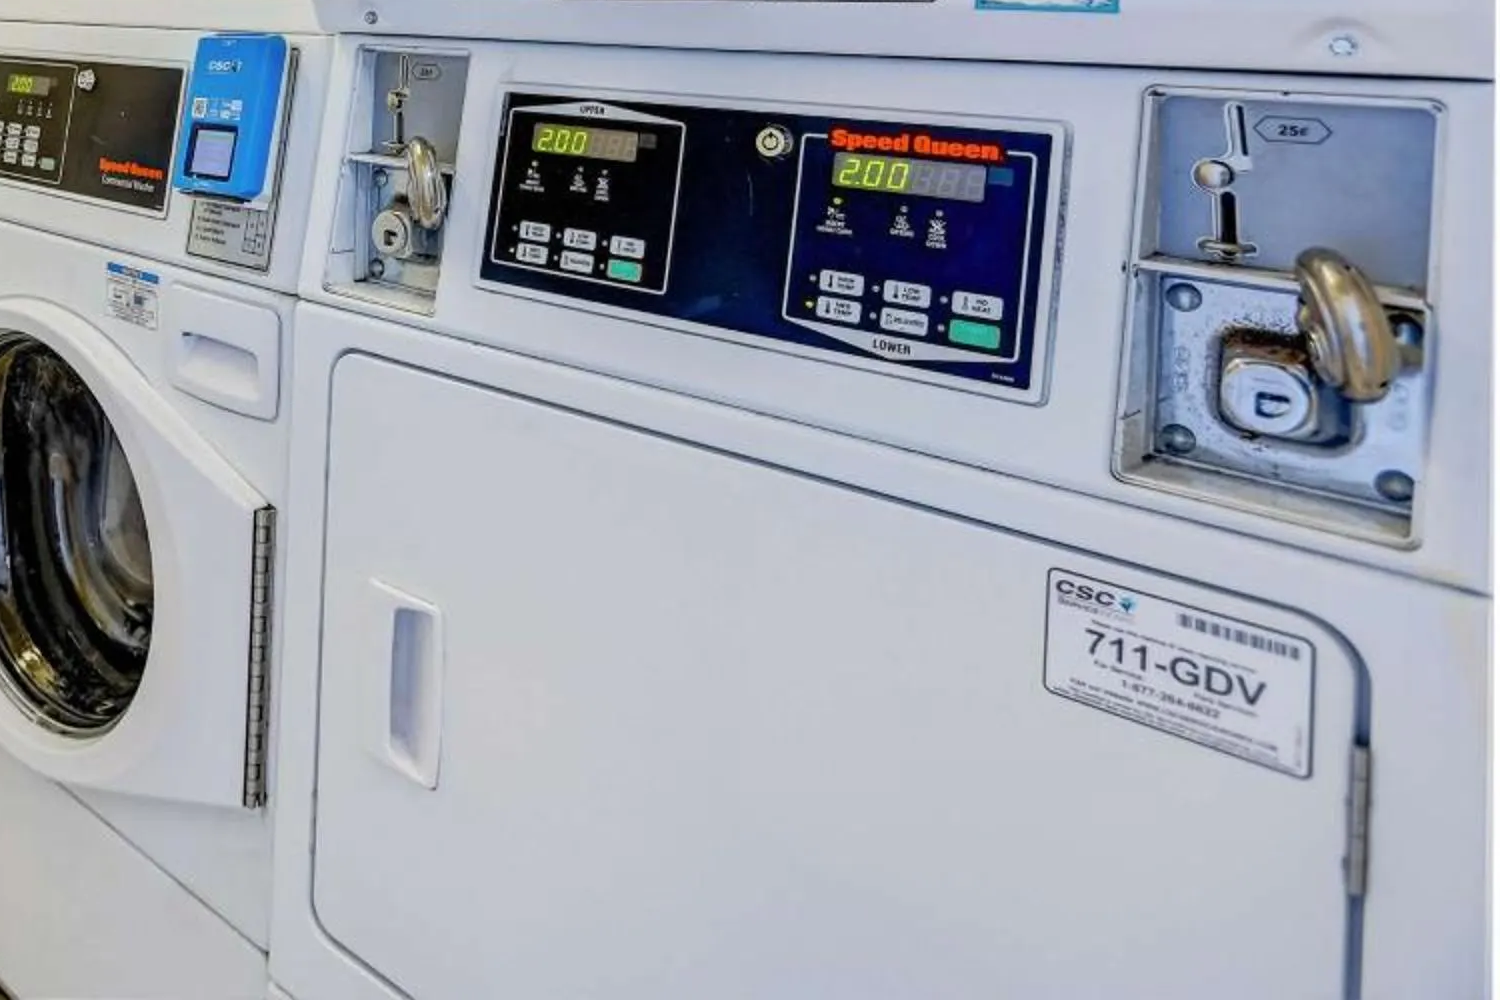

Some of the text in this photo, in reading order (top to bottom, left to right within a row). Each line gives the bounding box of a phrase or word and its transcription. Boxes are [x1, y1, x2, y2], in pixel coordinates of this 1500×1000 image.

[580, 105, 605, 115] UPPER
[831, 128, 1000, 161] Speed Queen
[838, 158, 910, 190] 2.00
[903, 287, 920, 295] LOW
[971, 305, 991, 313] HEAT
[975, 299, 988, 307] NO
[872, 338, 911, 355] LOWER
[1056, 580, 1115, 606] CSC
[1084, 628, 1267, 706] 711-GDV
